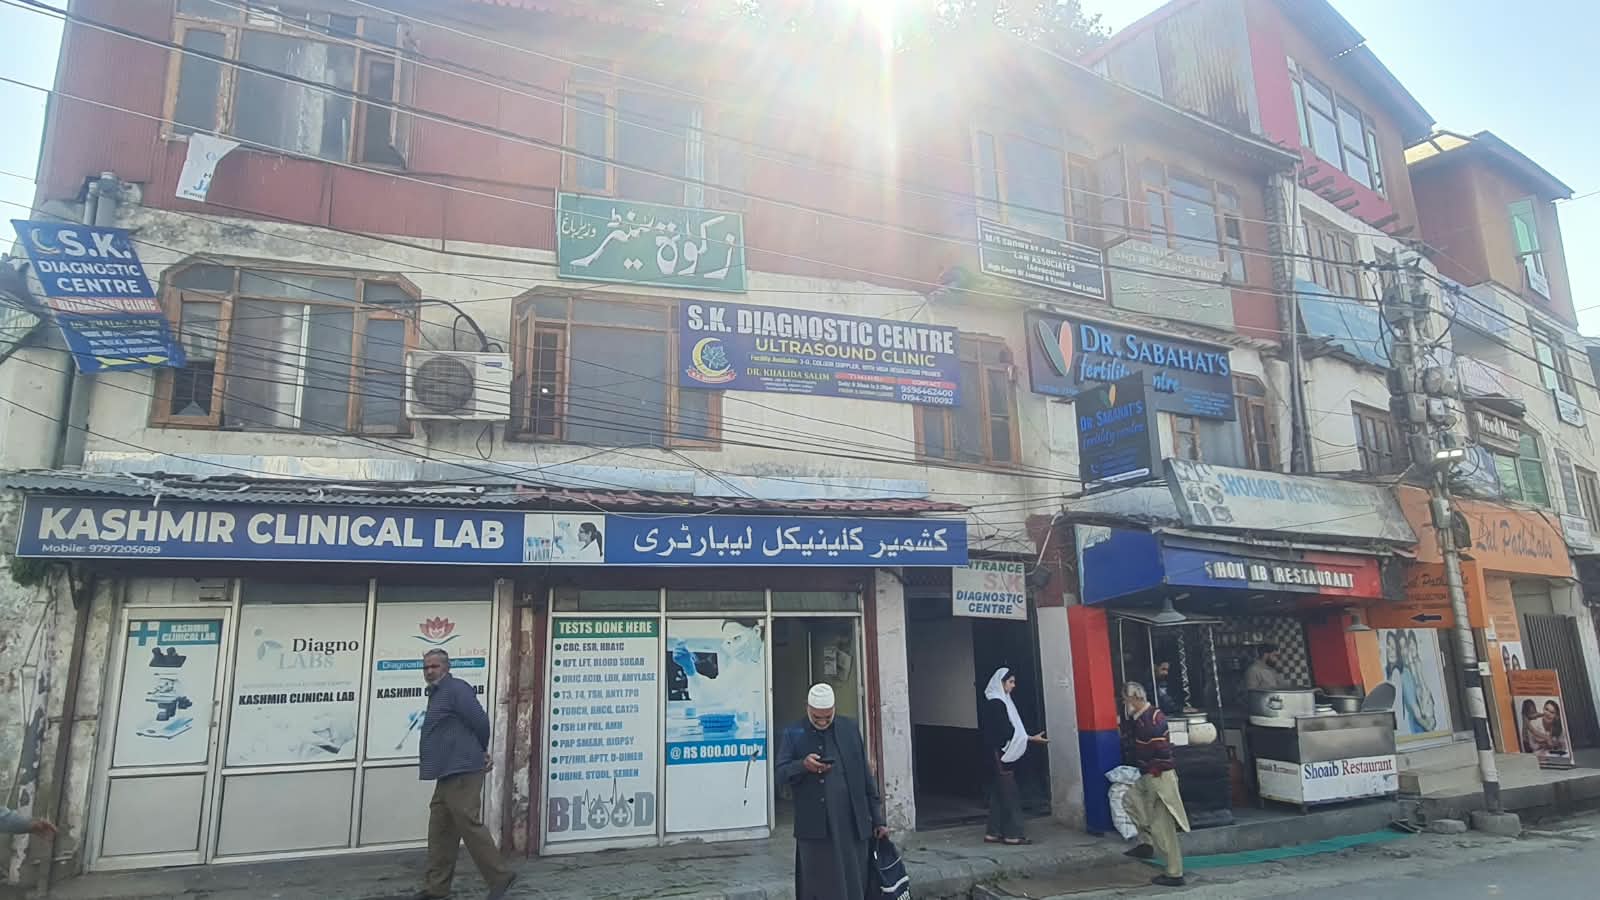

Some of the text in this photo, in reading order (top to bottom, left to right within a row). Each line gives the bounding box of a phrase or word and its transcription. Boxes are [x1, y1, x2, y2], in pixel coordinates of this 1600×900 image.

[58, 230, 132, 259] S.K.
[37, 260, 142, 276] DIAGNOSTIC
[1032, 255, 1076, 273] ASSOCIATES
[57, 278, 142, 293] CENTRE
[687, 304, 955, 355] S.K. DIAGNOSTIC CENTRE
[755, 338, 936, 368] ULTRASOUND CLINIC
[1079, 324, 1229, 376] DR. SABAHAT'S
[763, 368, 802, 379] KHALIDA
[804, 371, 830, 381] SALIM
[38, 507, 505, 549] KASHMIR CLINICAL LAB
[634, 523, 948, 559] کشمیر کلینیکل لیبارٹری
[89, 544, 161, 554] 9797205089
[1273, 567, 1355, 588] RESTAURANT
[956, 590, 1024, 603] DIAGNOSTIC
[968, 602, 1013, 614] CENTRE
[170, 623, 210, 632] KASHMIR
[559, 621, 652, 634] TESTS DONE HERE
[161, 631, 217, 642] CLINICAL LAB
[292, 638, 359, 655] Diagno
[593, 658, 618, 667] BLOOD
[621, 672, 656, 682] AMYLASE
[239, 691, 355, 706] KASHMIR CLINICAL LAB
[377, 687, 422, 699] KASHMIR
[683, 746, 698, 759] RS
[700, 744, 738, 759] 800.00
[1304, 760, 1339, 780] Shoaib
[1342, 758, 1393, 776] Restaurant
